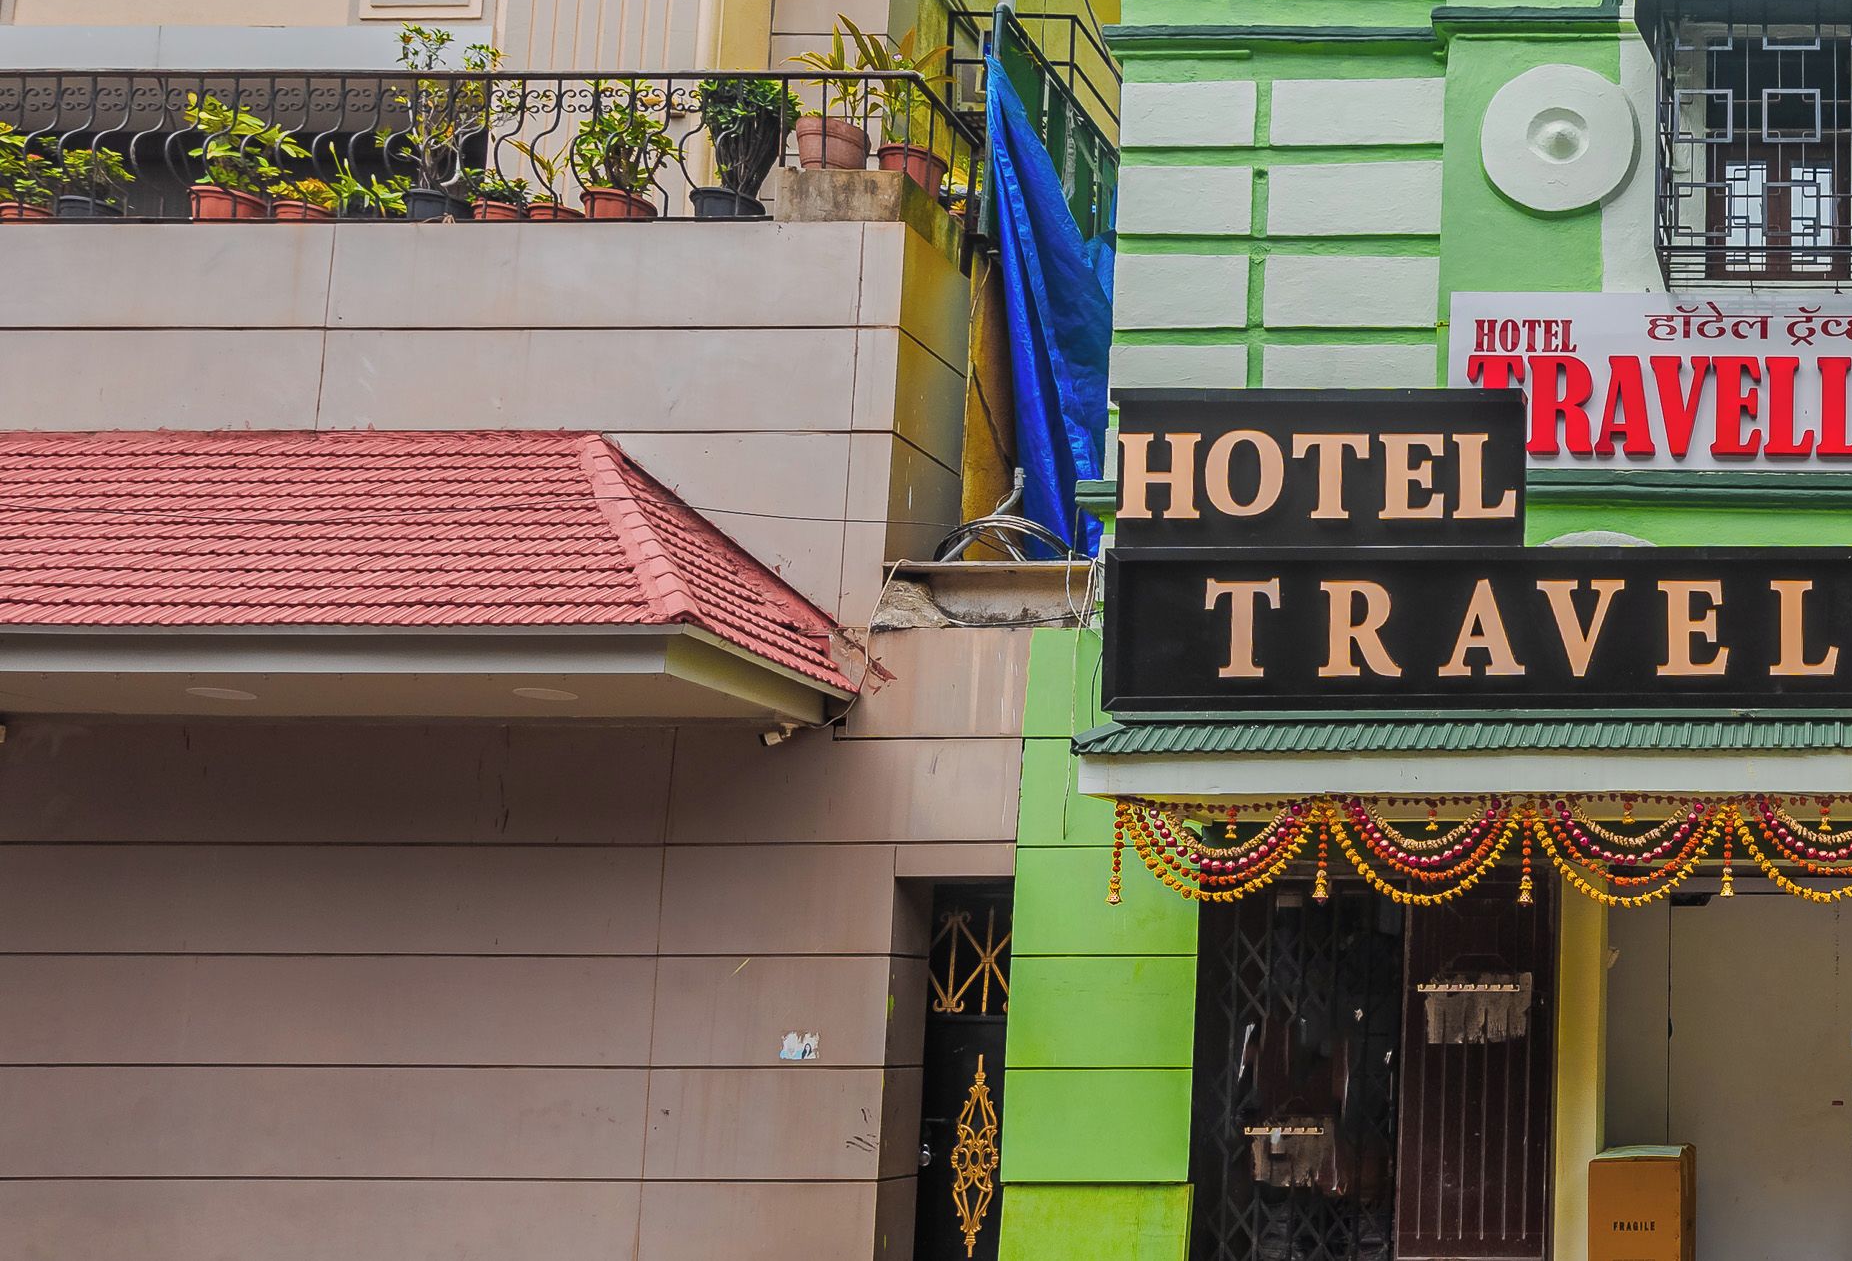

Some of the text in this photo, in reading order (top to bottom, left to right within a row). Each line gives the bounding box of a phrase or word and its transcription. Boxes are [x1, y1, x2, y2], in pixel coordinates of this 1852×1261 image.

[1474, 318, 1577, 353] HOTEL
[1644, 302, 1774, 341] हॉटेल
[1116, 429, 1517, 520] HOTEL
[1613, 1221, 1656, 1232] FRAGILE
